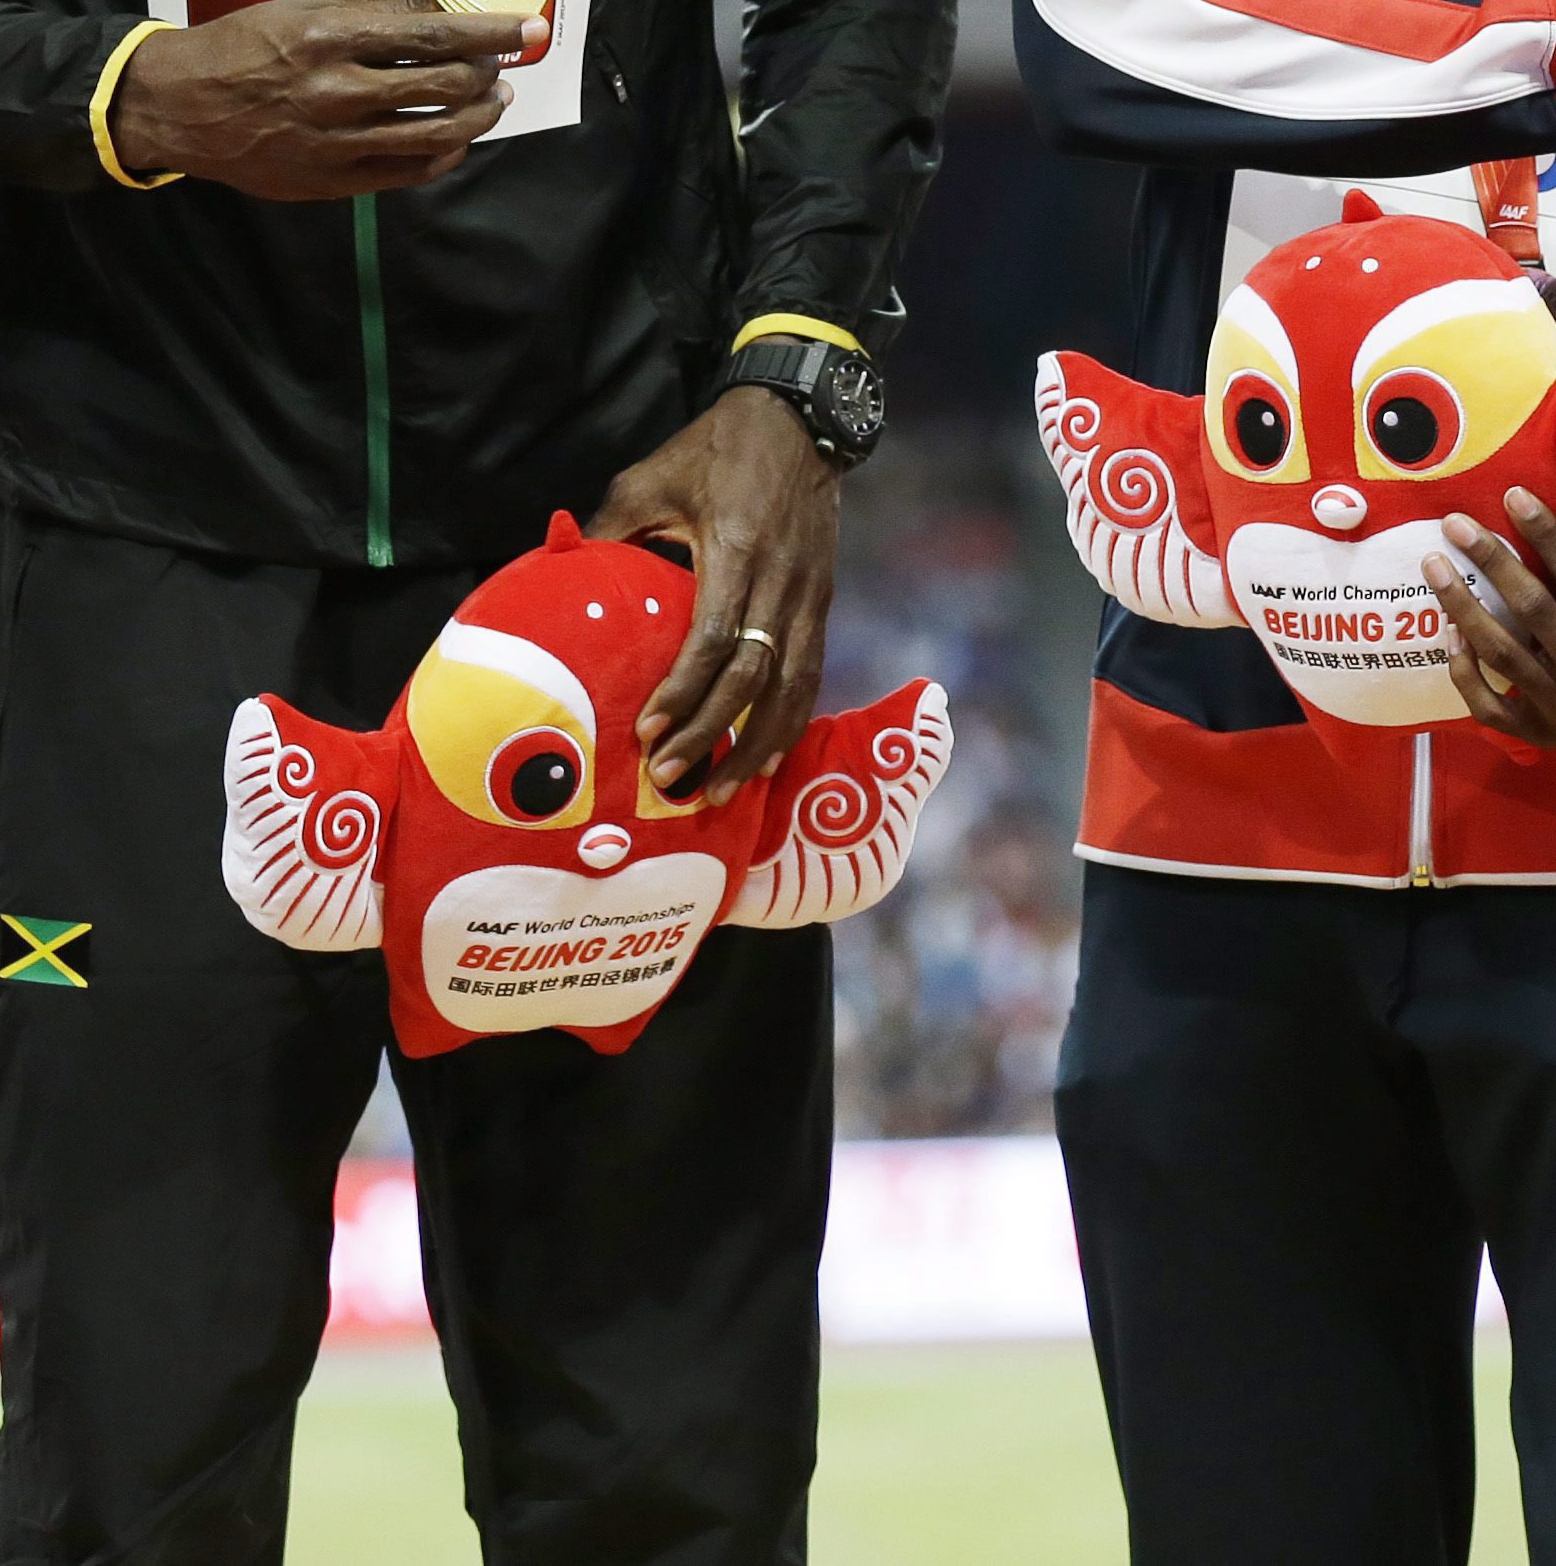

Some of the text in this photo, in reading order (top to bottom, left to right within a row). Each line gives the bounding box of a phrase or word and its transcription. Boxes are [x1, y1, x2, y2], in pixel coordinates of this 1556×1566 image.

[1499, 204, 1529, 219] IAAF
[1251, 583, 1287, 600] IAAF
[1292, 586, 1337, 602] World
[1263, 608, 1439, 642] BEIJING 20
[466, 902, 696, 936] IAAF World Championships
[456, 921, 691, 972] BEIJING 2015
[447, 956, 677, 997] 国际田联世界田径锦标赛
